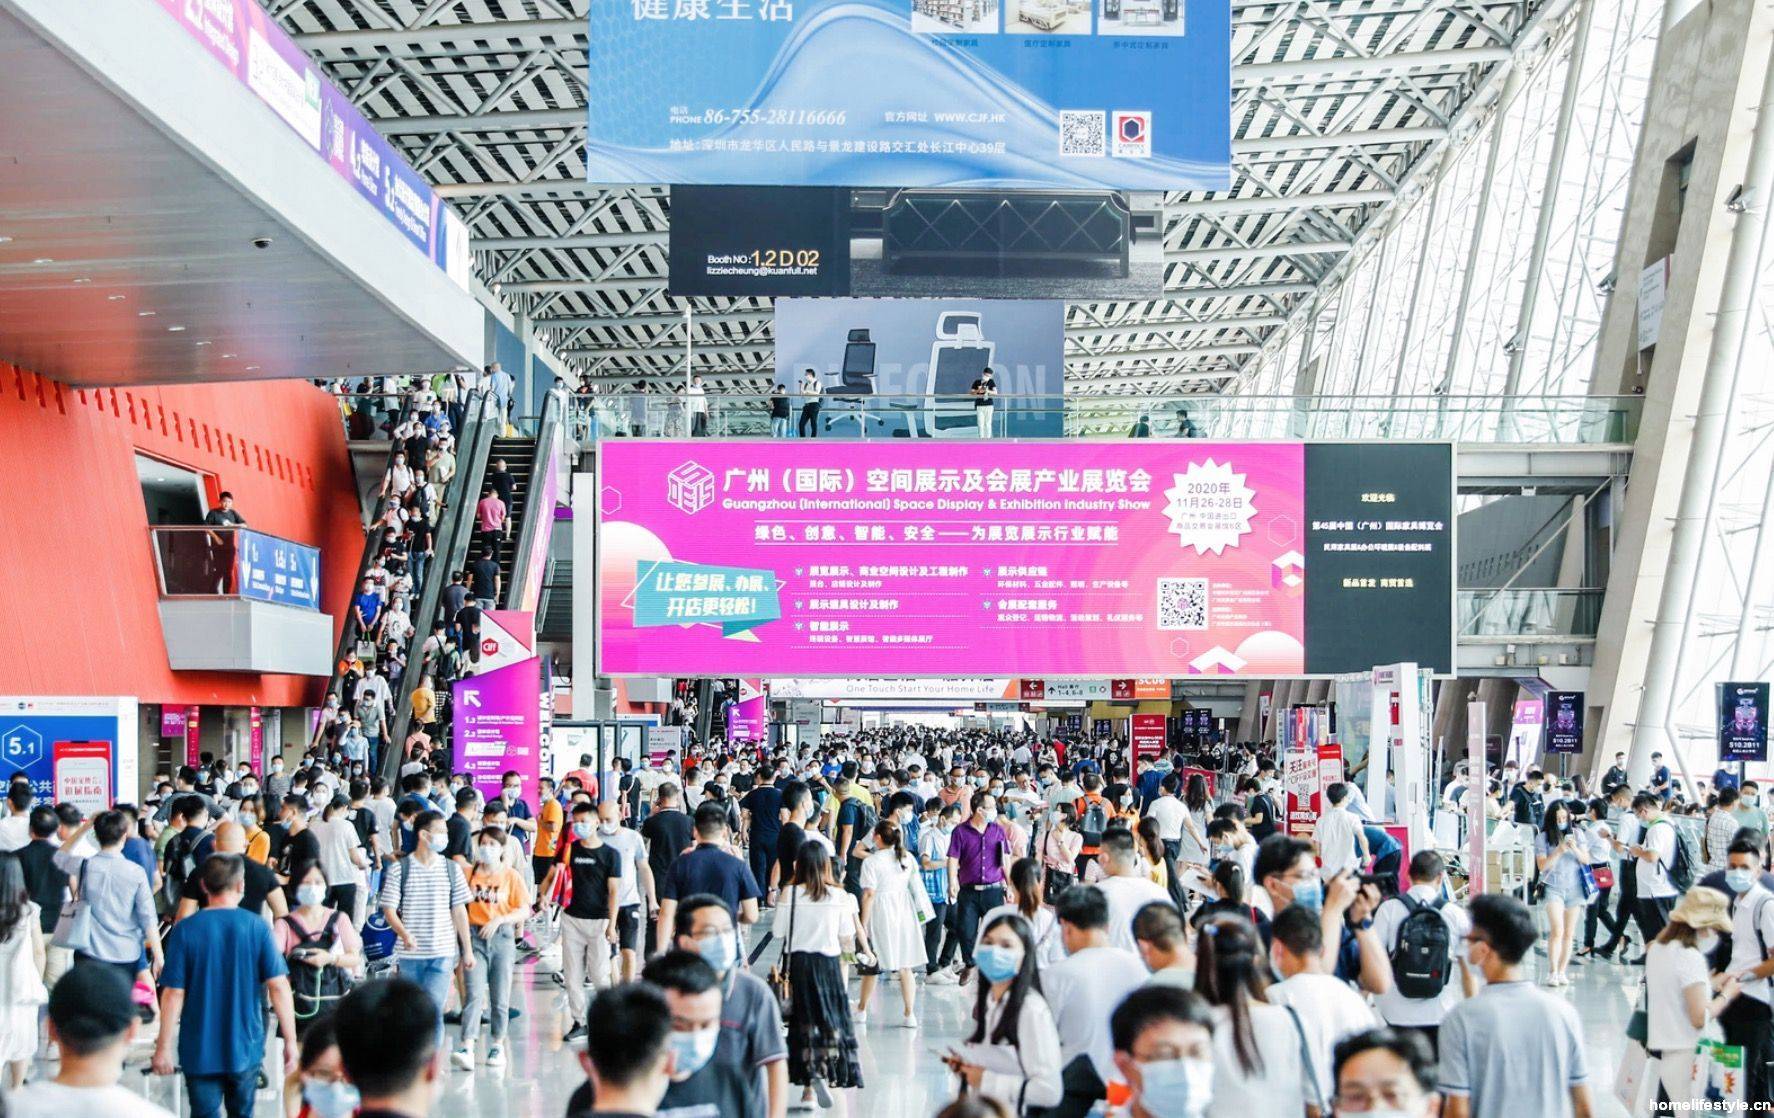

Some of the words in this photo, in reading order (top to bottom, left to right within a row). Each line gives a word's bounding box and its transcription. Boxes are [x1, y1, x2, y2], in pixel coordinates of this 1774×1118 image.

[670, 115, 702, 124] PHONE
[704, 109, 846, 125] 86-755-28116666
[885, 112, 929, 122] 官方网址
[707, 255, 732, 263] Booth
[722, 467, 1152, 493] 广州（国际）空间展示及会展产业展览会
[1188, 482, 1231, 495] 2020年
[722, 499, 796, 511] Guangzhou
[893, 499, 934, 511] Space
[937, 498, 984, 511] Display
[988, 499, 997, 510] &
[1001, 499, 1061, 510] Exhibition
[1065, 499, 1116, 511] Industry
[1118, 499, 1151, 510] Show
[846, 685, 866, 693] One
[869, 685, 895, 693] Touch
[898, 685, 921, 693] Start
[923, 685, 945, 693] Your
[947, 685, 975, 693] Home
[977, 685, 994, 693] Life
[9, 736, 35, 755] 5.1
